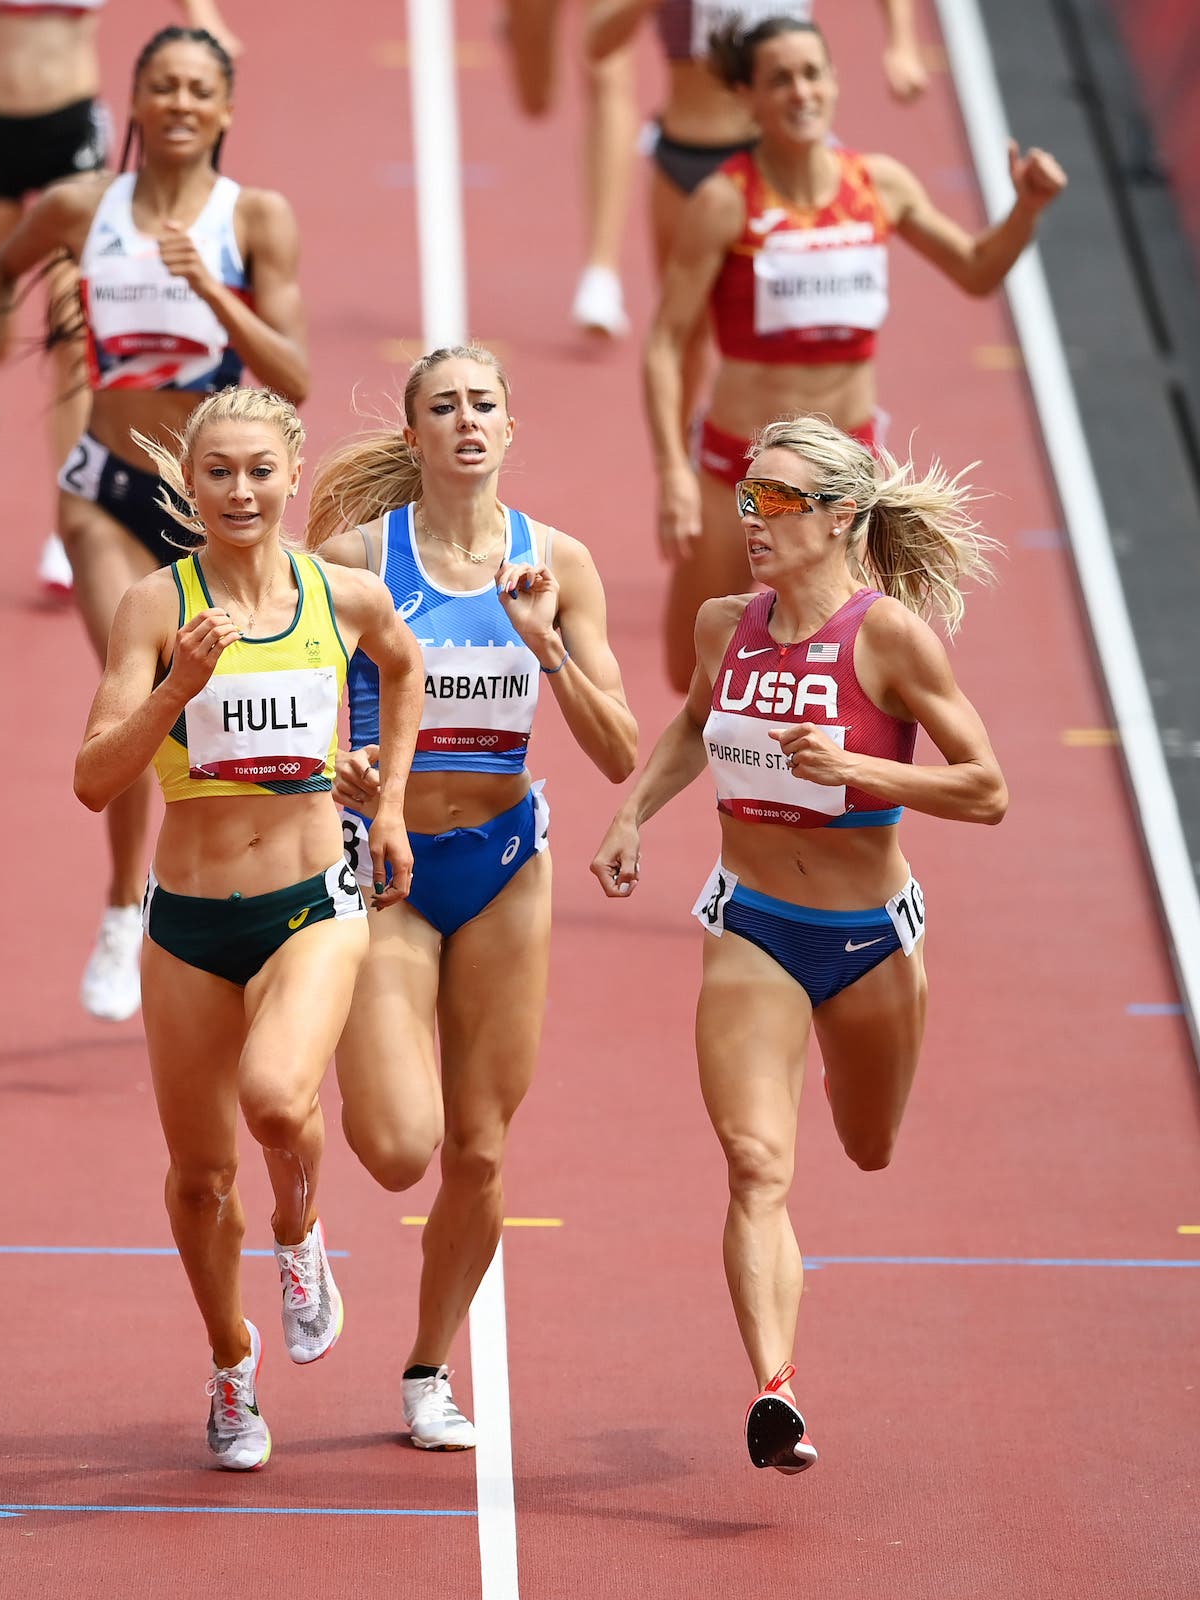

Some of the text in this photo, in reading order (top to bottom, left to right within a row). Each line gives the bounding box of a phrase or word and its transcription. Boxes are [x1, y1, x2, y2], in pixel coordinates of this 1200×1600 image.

[65, 444, 88, 489] 2
[424, 673, 530, 700] ABBATINI
[719, 668, 839, 719] USA
[222, 696, 308, 732] HULL
[433, 735, 475, 745] TOKYO 2020
[709, 742, 761, 768] PURRIER
[234, 765, 277, 775] TOKYO 2020
[742, 806, 780, 818] TOKYO 2020
